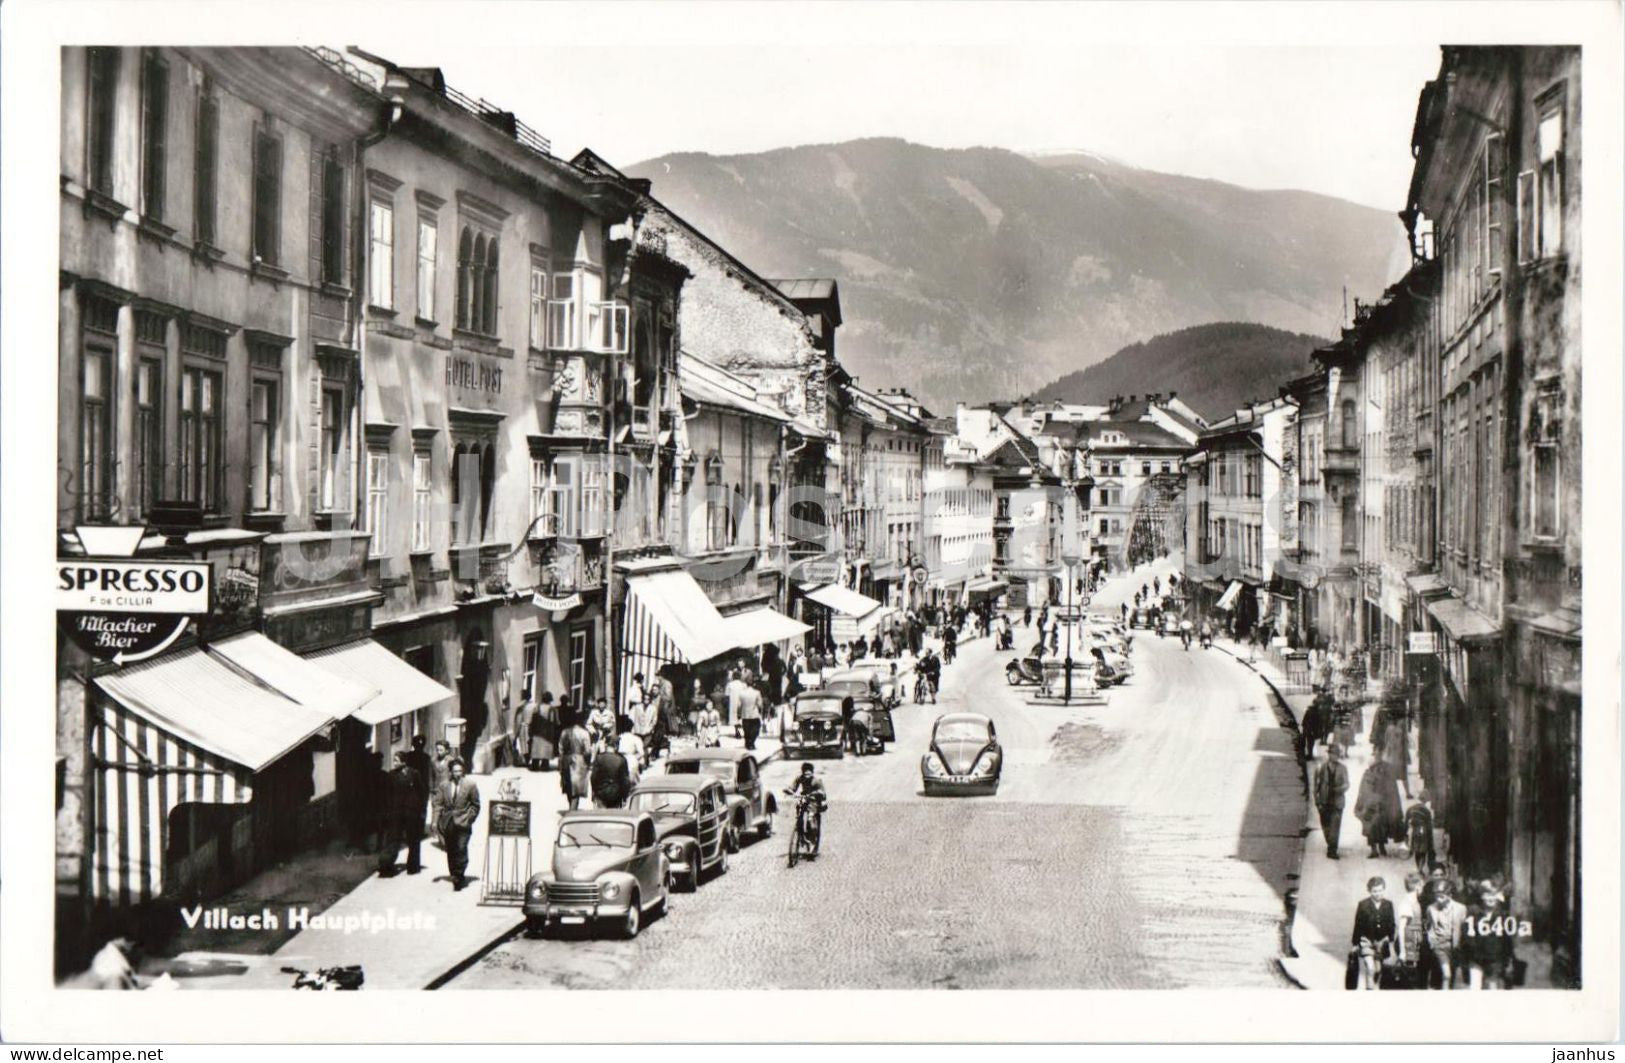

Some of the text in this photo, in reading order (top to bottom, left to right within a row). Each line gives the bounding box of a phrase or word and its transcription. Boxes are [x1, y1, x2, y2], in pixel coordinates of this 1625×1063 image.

[445, 356, 503, 394] HOTEL POST
[57, 566, 204, 593] SPRESSO
[116, 596, 153, 606] CILLIA
[94, 632, 139, 648] Bier
